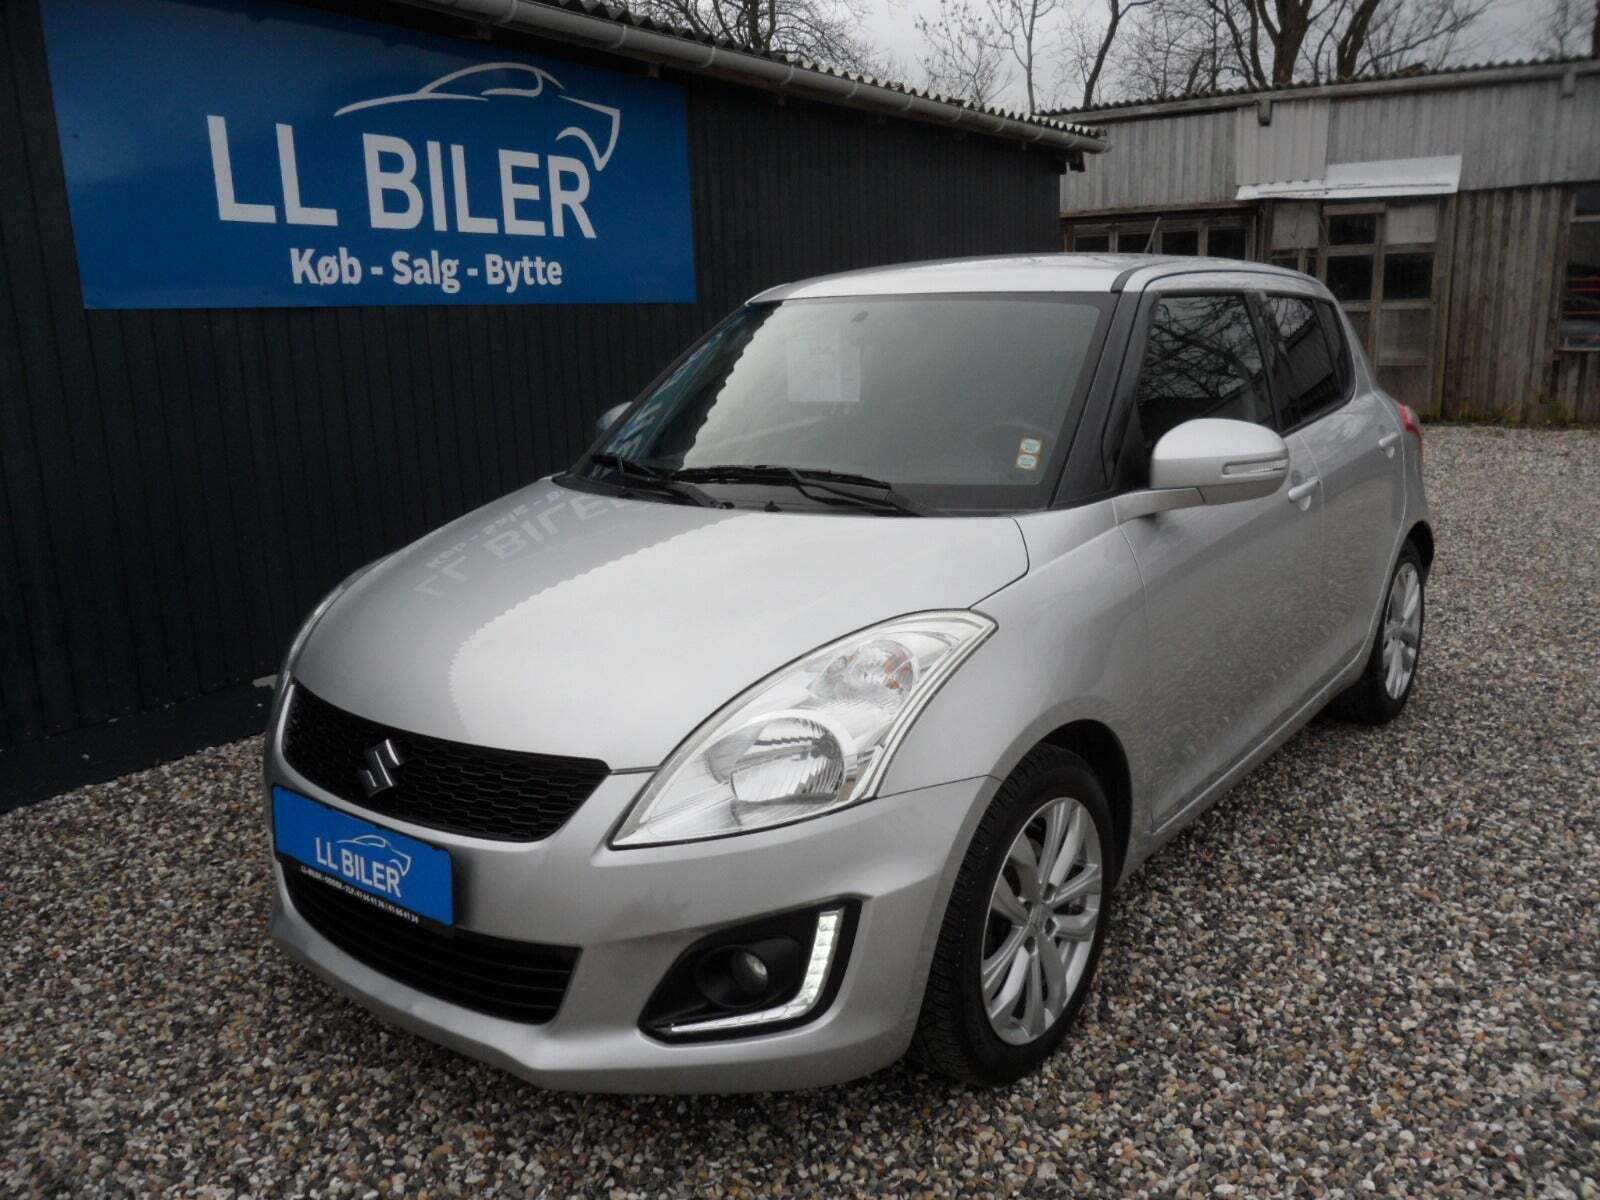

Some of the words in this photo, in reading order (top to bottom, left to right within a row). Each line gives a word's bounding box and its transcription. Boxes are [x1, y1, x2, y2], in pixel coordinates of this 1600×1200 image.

[207, 115, 338, 226] LL
[362, 132, 597, 239] BILER
[290, 247, 362, 286] Køb
[391, 250, 462, 294] Salg
[485, 254, 563, 294] Bytte
[315, 837, 338, 870] LL
[341, 848, 402, 898] BILER
